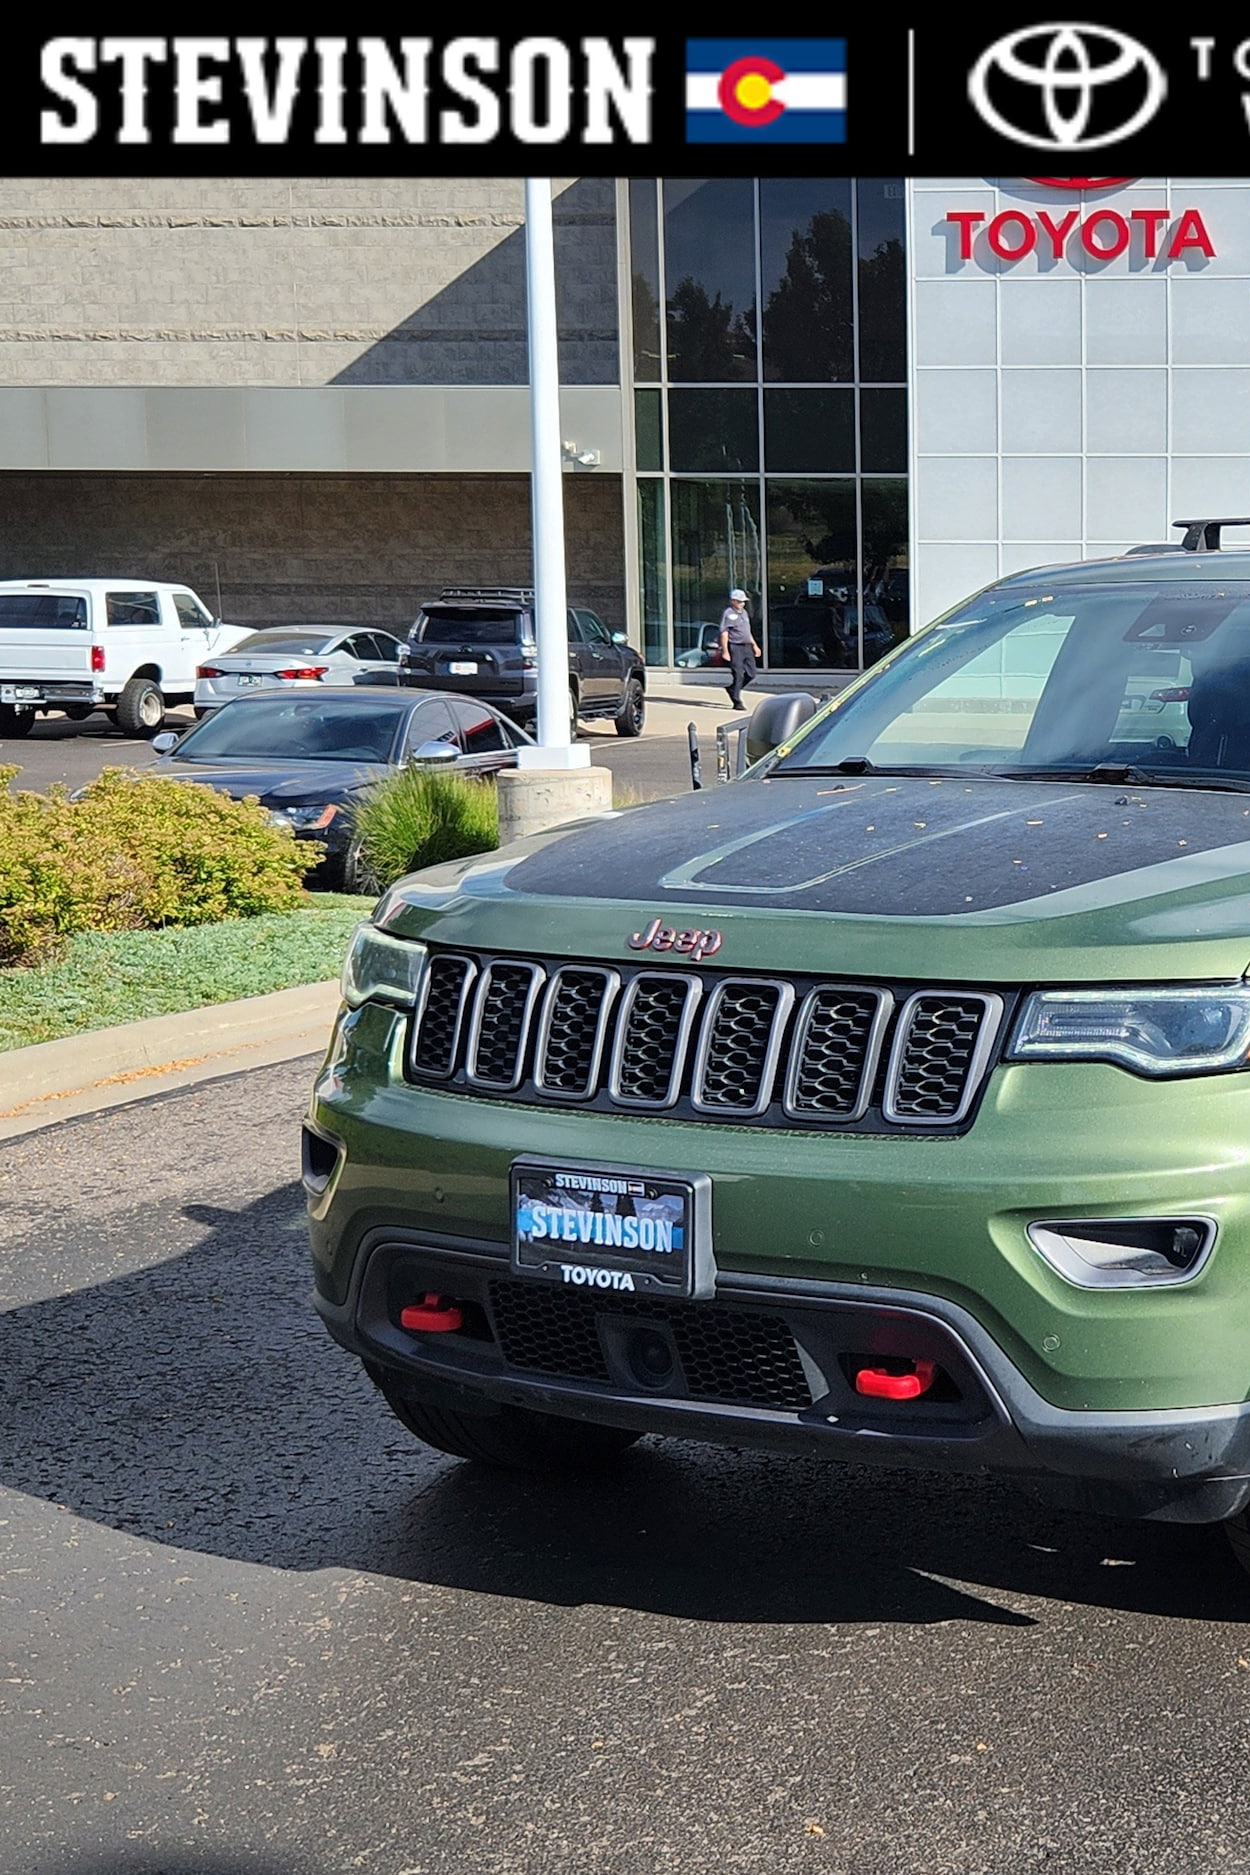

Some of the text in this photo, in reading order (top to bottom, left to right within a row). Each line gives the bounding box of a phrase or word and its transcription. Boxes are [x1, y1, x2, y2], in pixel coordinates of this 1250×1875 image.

[946, 209, 1216, 261] TOYOTA
[628, 918, 722, 962] Jeep
[555, 1174, 628, 1195] STEVINSON
[531, 1205, 674, 1254] STEVINSON
[560, 1264, 635, 1292] TOYOTA
